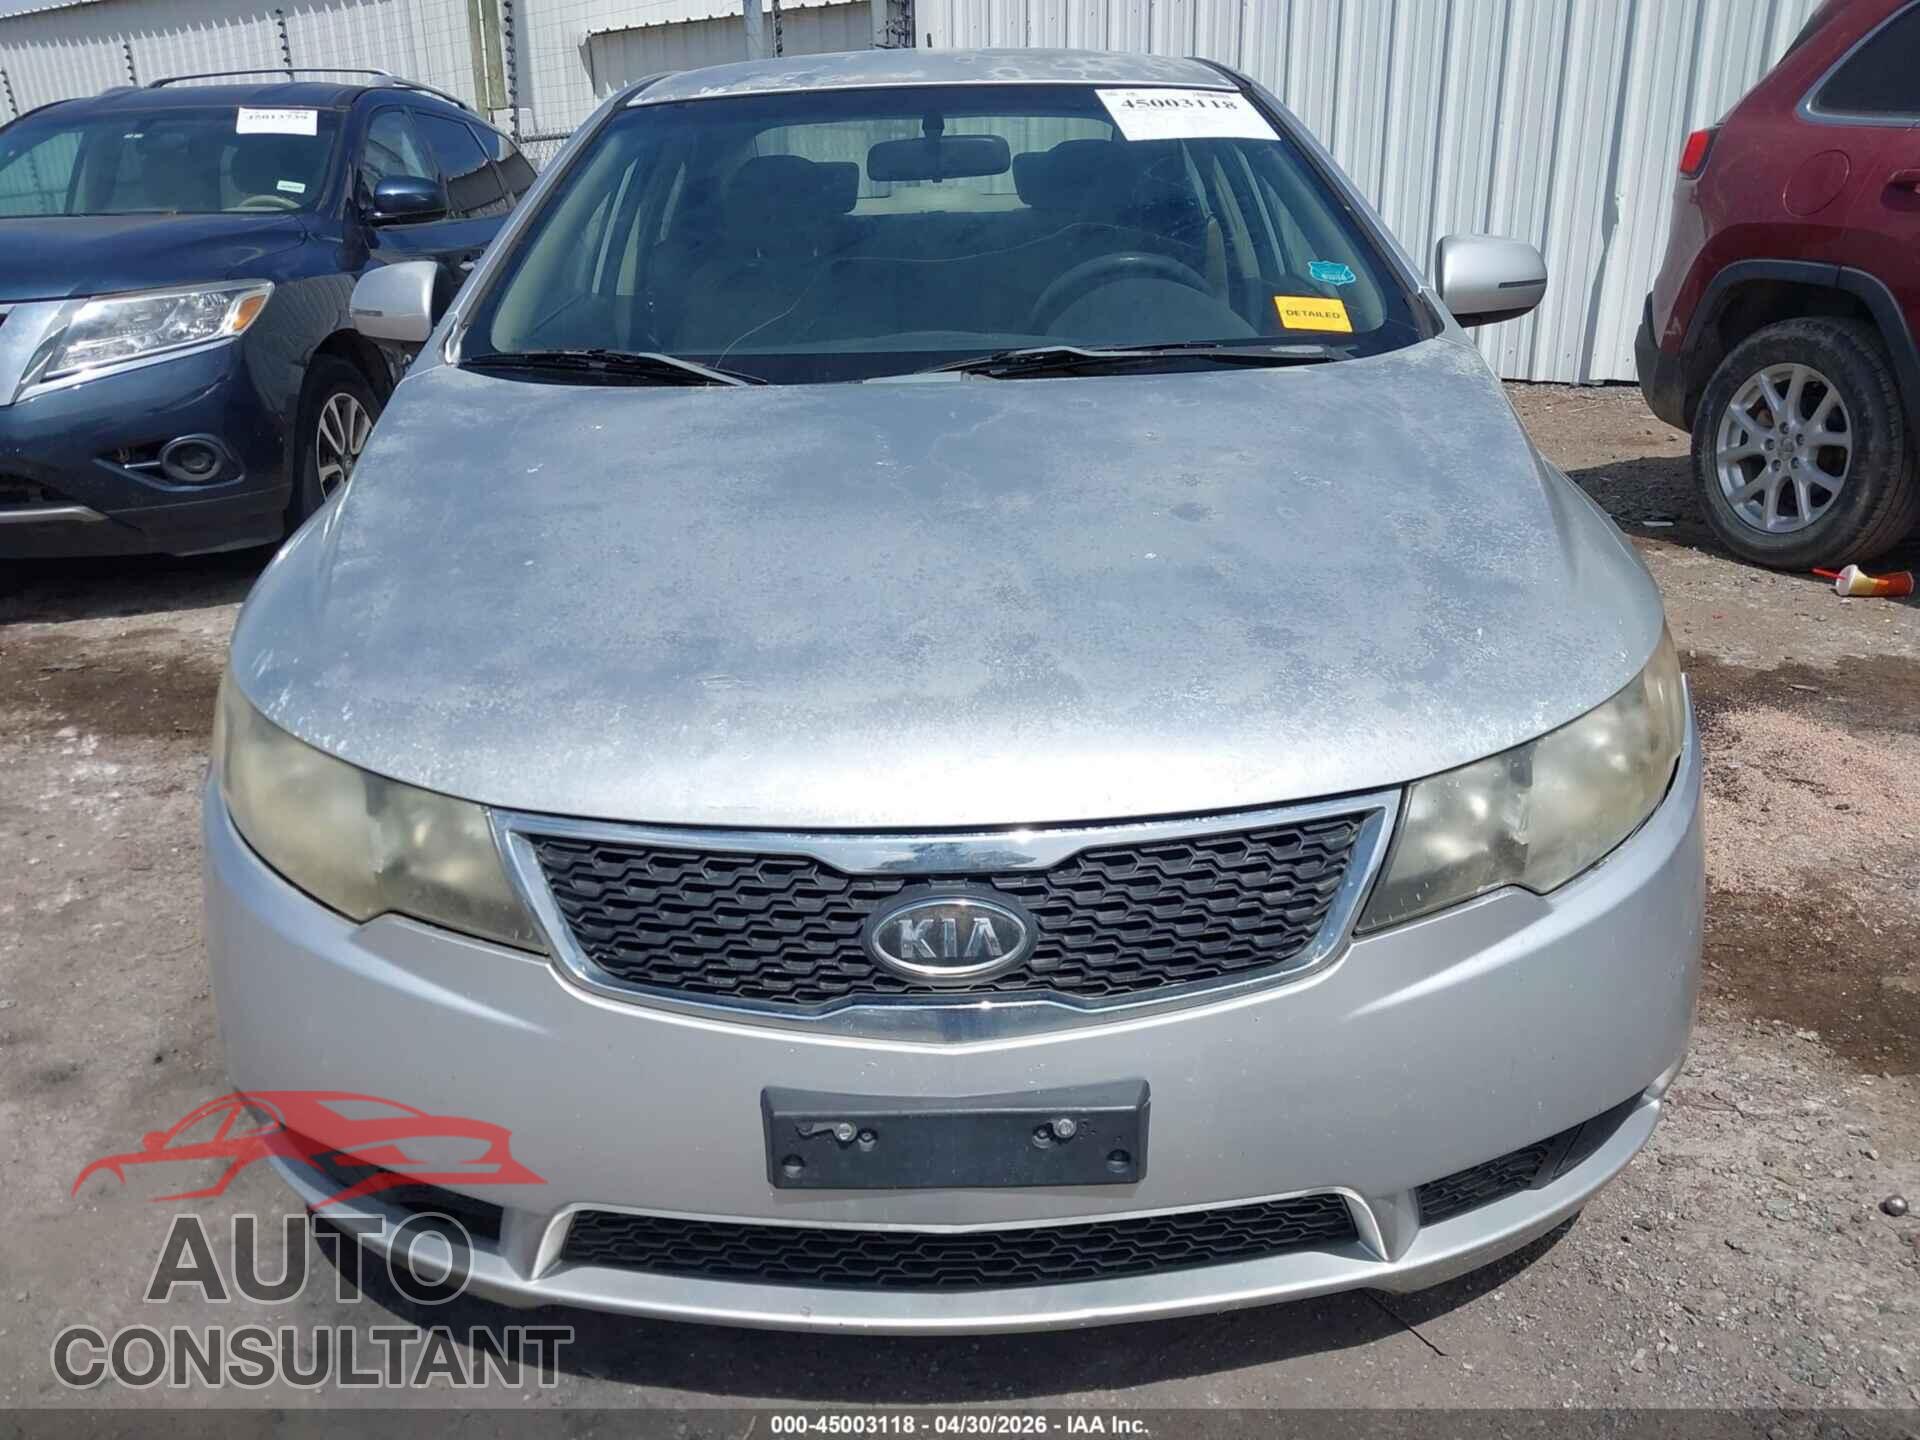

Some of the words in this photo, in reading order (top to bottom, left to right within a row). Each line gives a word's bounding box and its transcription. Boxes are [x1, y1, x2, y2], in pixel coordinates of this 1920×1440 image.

[1120, 97, 1239, 111] 45003118
[1285, 308, 1341, 320] DETAILED
[899, 917, 1003, 959] KIA
